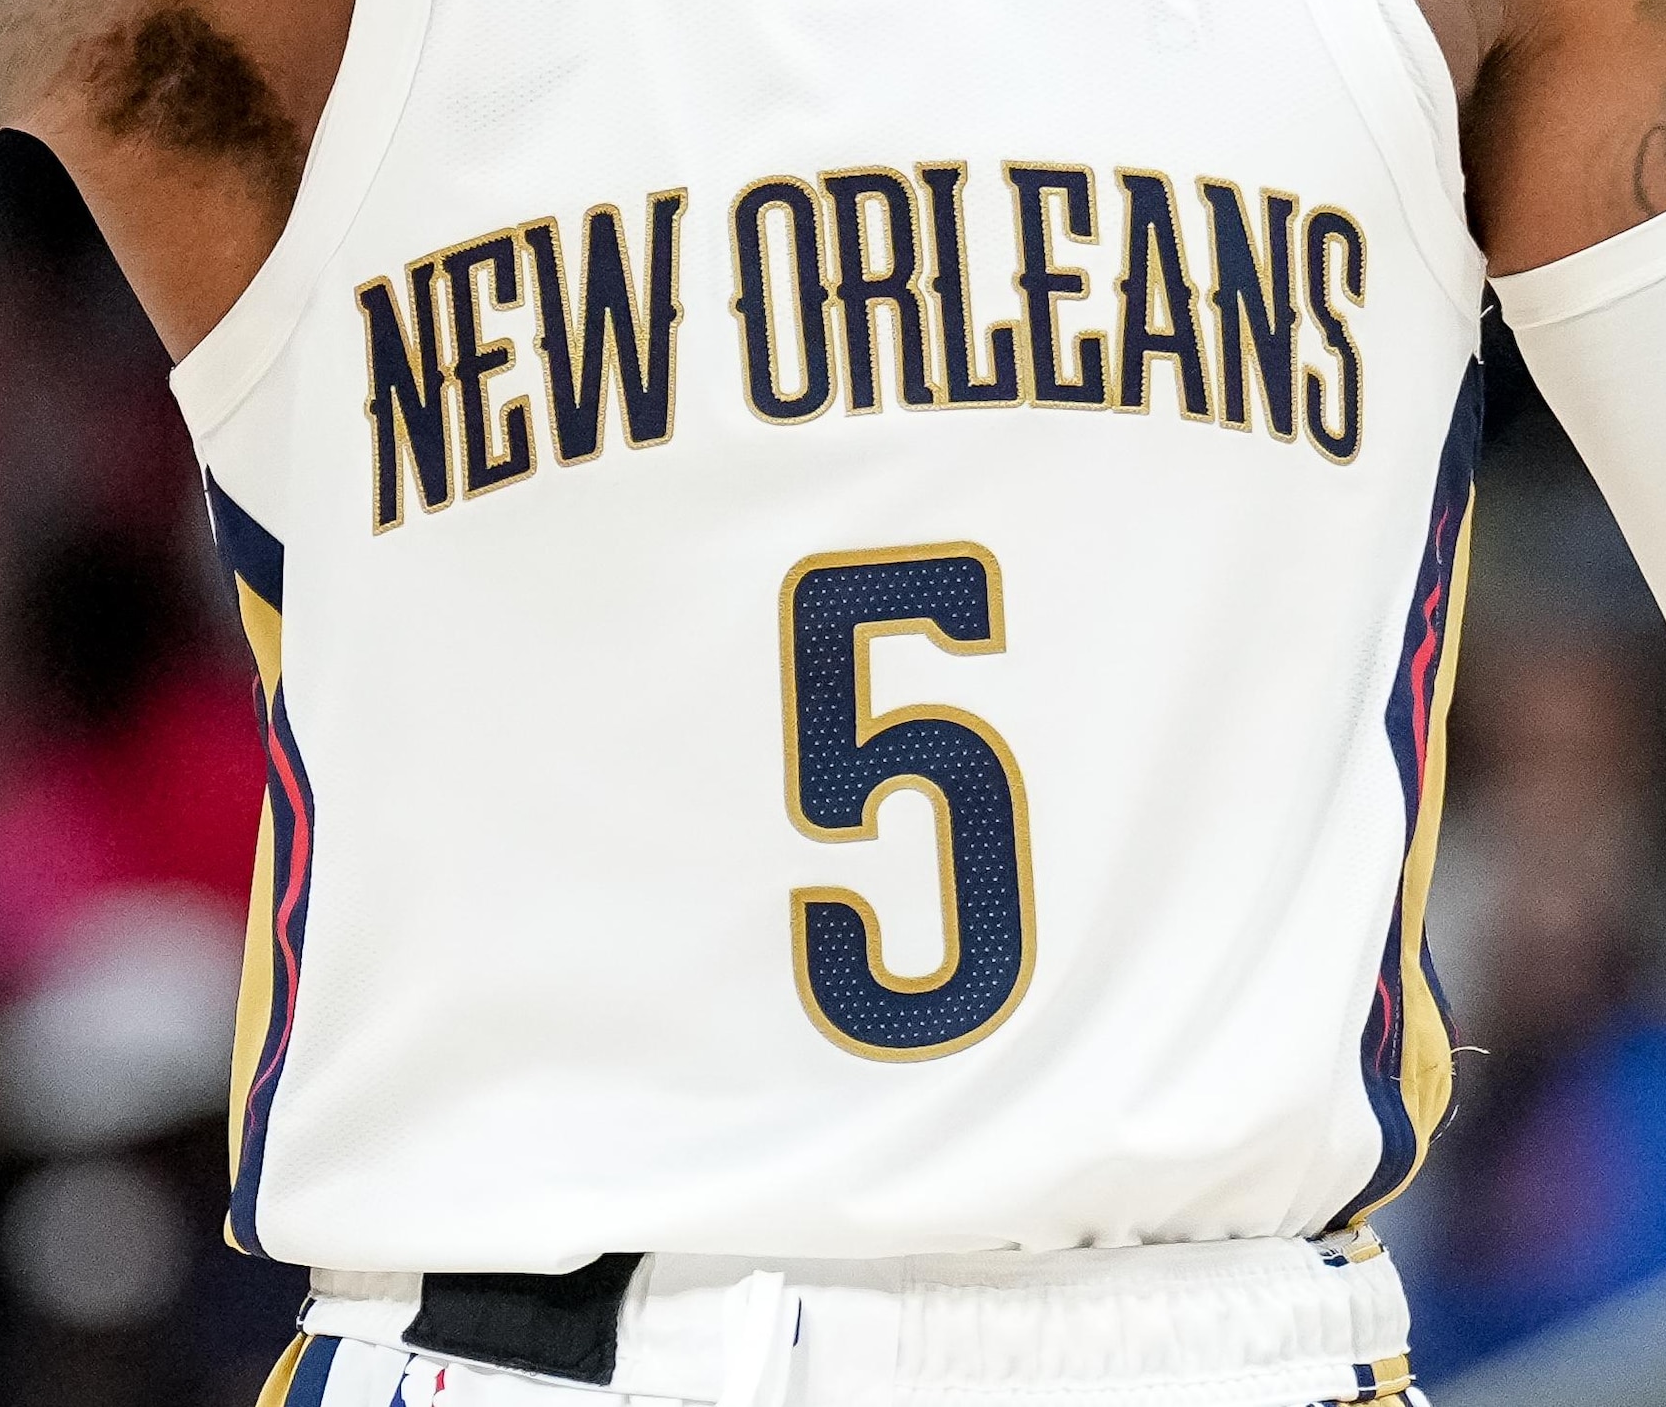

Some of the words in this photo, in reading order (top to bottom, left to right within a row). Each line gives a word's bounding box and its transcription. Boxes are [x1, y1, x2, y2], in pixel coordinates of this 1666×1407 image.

[354, 186, 689, 536] NEW
[727, 159, 1368, 466] ORLEANS
[778, 539, 1038, 1063] 5
